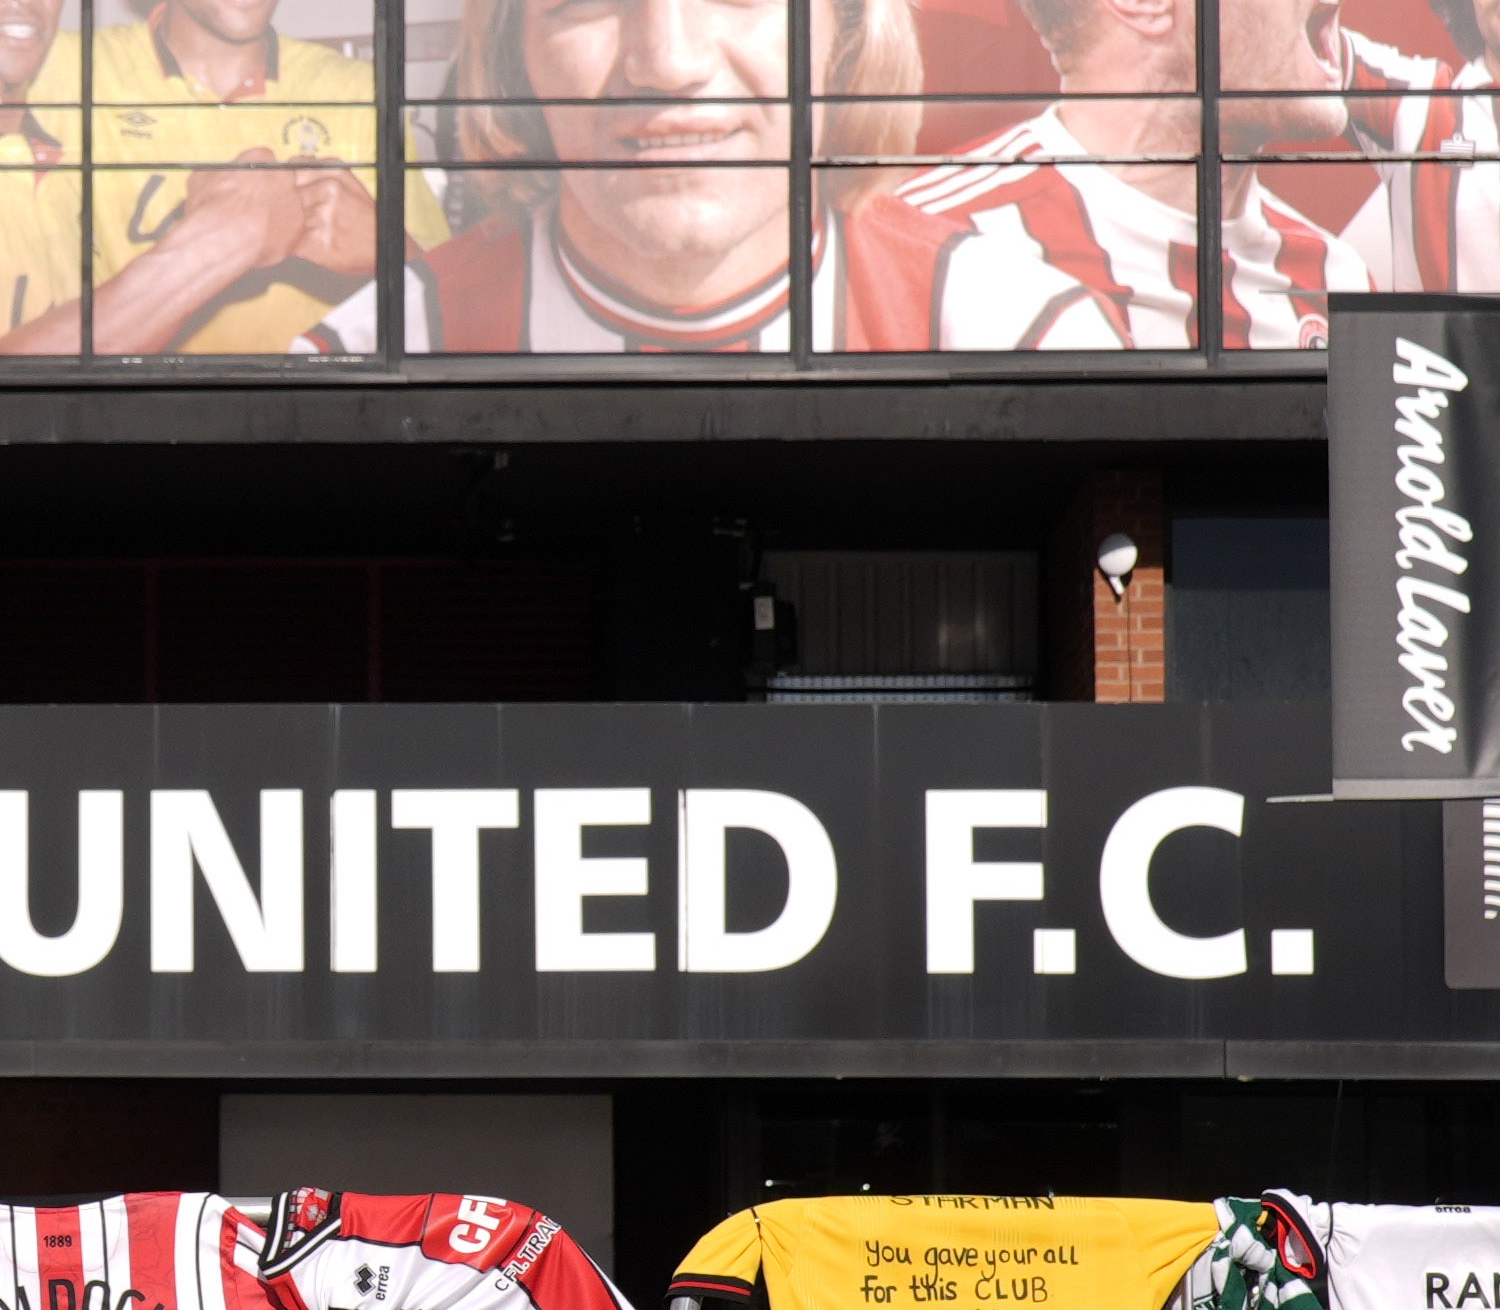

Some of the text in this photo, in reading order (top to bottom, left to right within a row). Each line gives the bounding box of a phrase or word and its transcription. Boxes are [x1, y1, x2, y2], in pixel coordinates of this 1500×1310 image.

[1393, 336, 1473, 755] Arnold Laver
[925, 784, 1315, 981] F.C.
[43, 1234, 73, 1249] 1889
[924, 1244, 978, 1281] gave
[375, 1264, 391, 1302] errea
[860, 1274, 898, 1304] for
[910, 1272, 958, 1303] this
